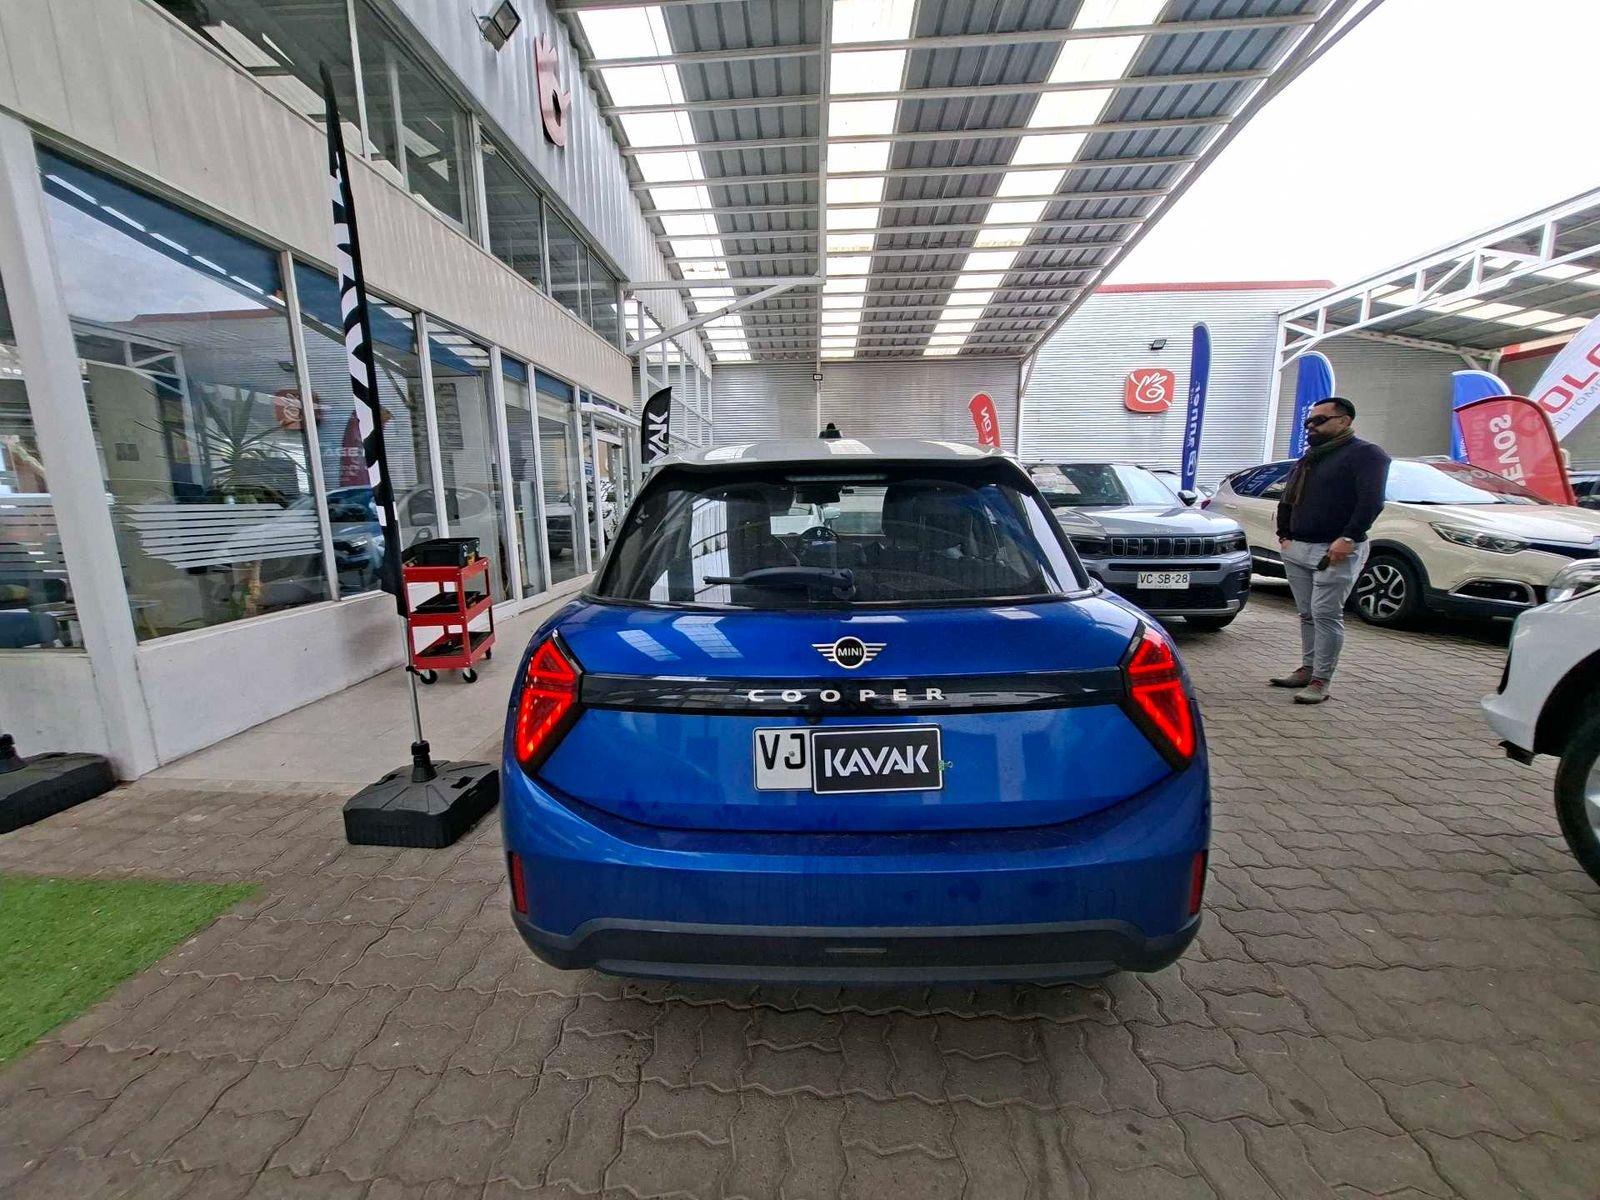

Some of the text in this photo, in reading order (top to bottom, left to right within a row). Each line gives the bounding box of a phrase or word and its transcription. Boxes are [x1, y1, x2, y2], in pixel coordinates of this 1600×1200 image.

[837, 647, 863, 657] MINI
[747, 687, 946, 702] COOPER
[759, 732, 806, 771] VJ
[824, 745, 929, 778] KAVAK
